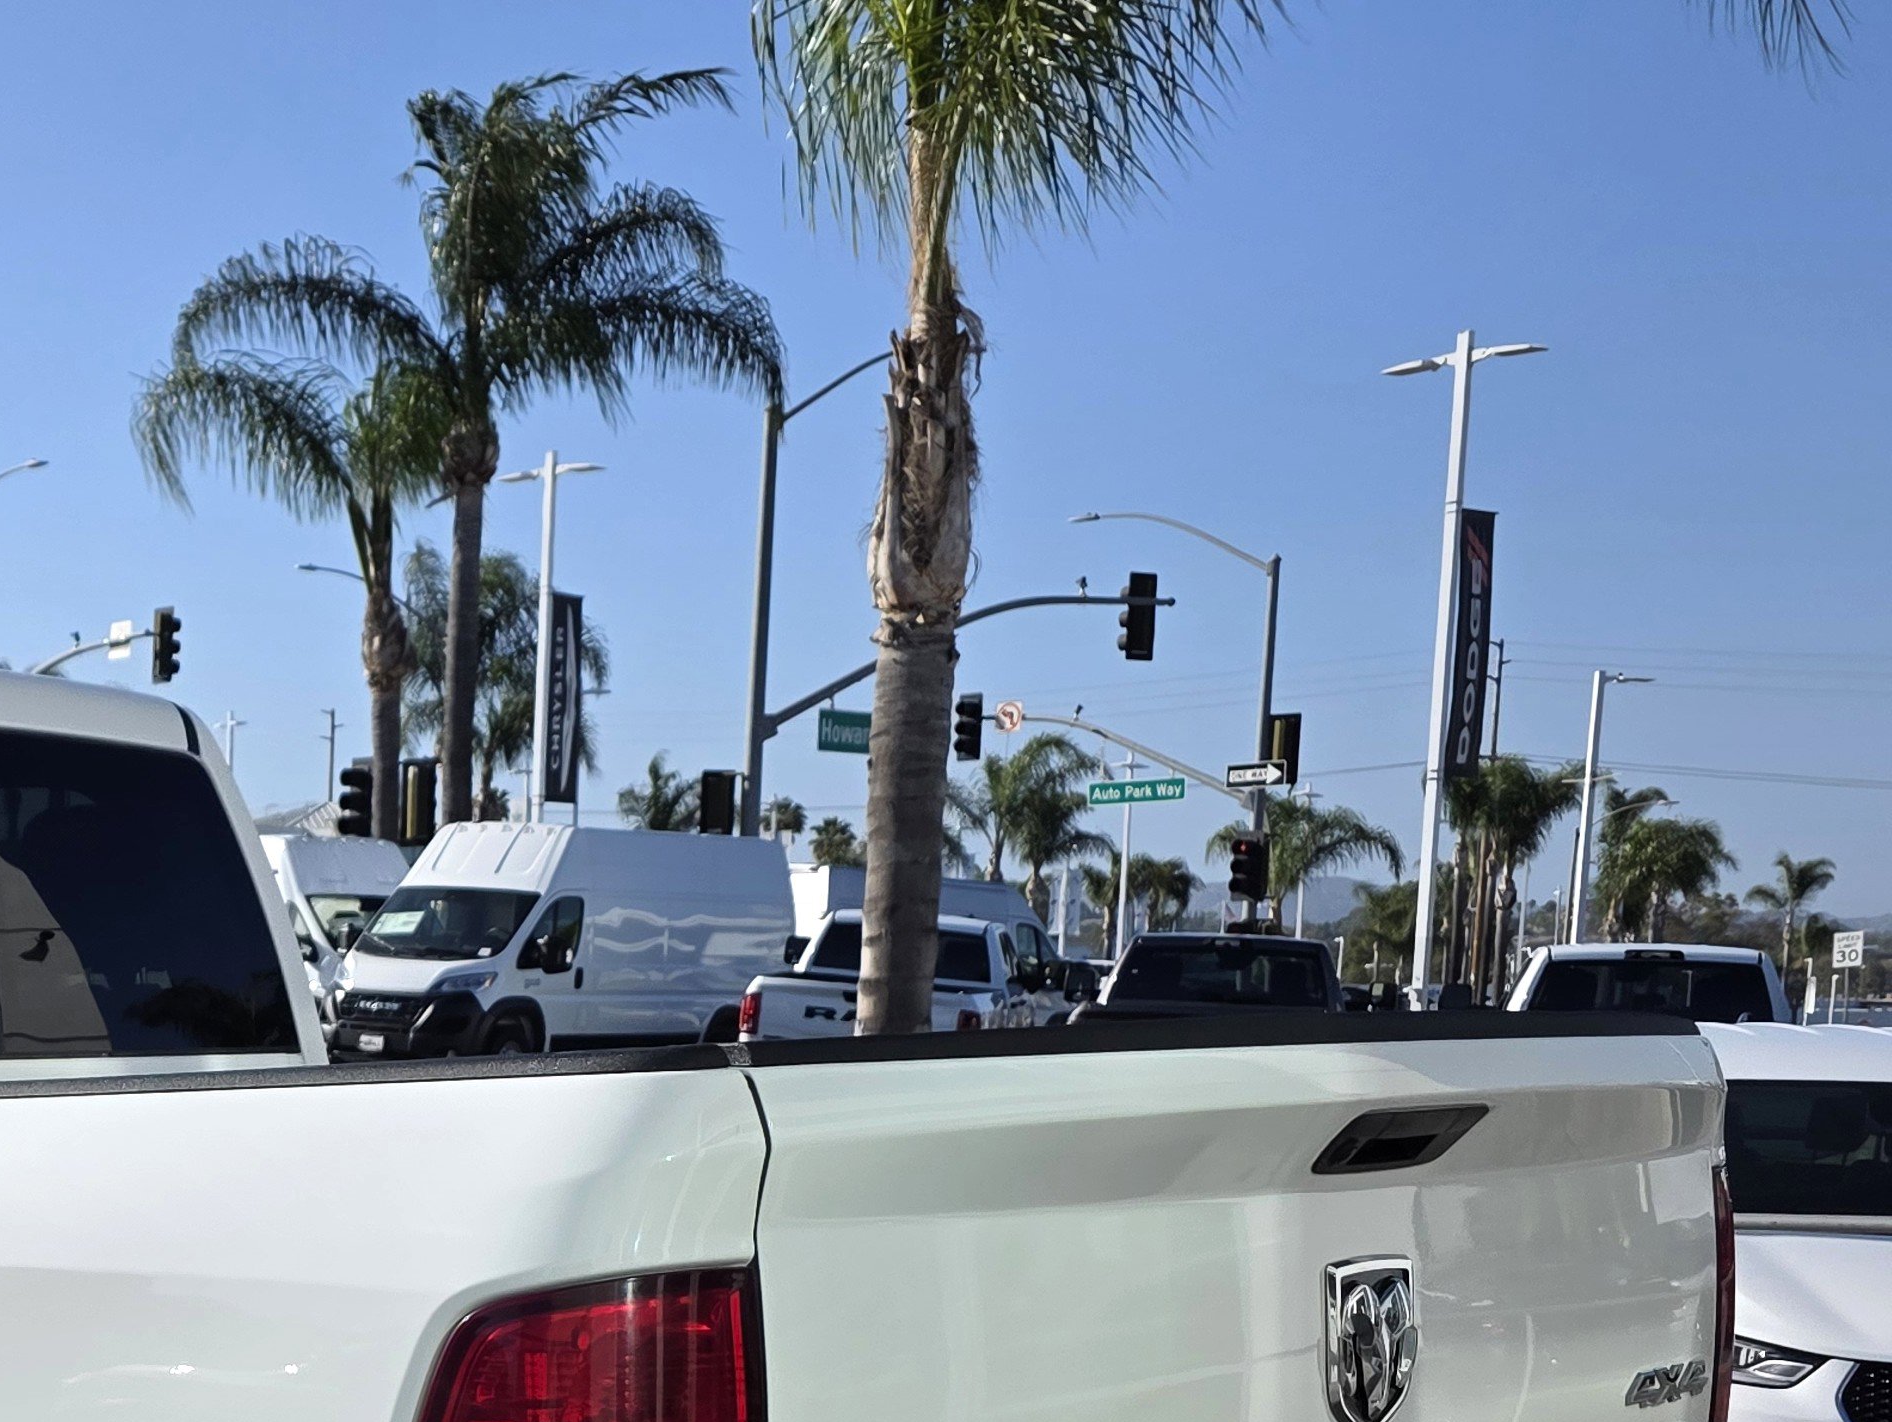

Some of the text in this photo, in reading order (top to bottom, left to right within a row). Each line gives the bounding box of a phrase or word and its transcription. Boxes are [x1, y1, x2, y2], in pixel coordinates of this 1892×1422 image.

[1456, 558, 1483, 764] DODGE
[1091, 782, 1182, 800] Auto Park Way
[1835, 949, 1859, 963] 30
